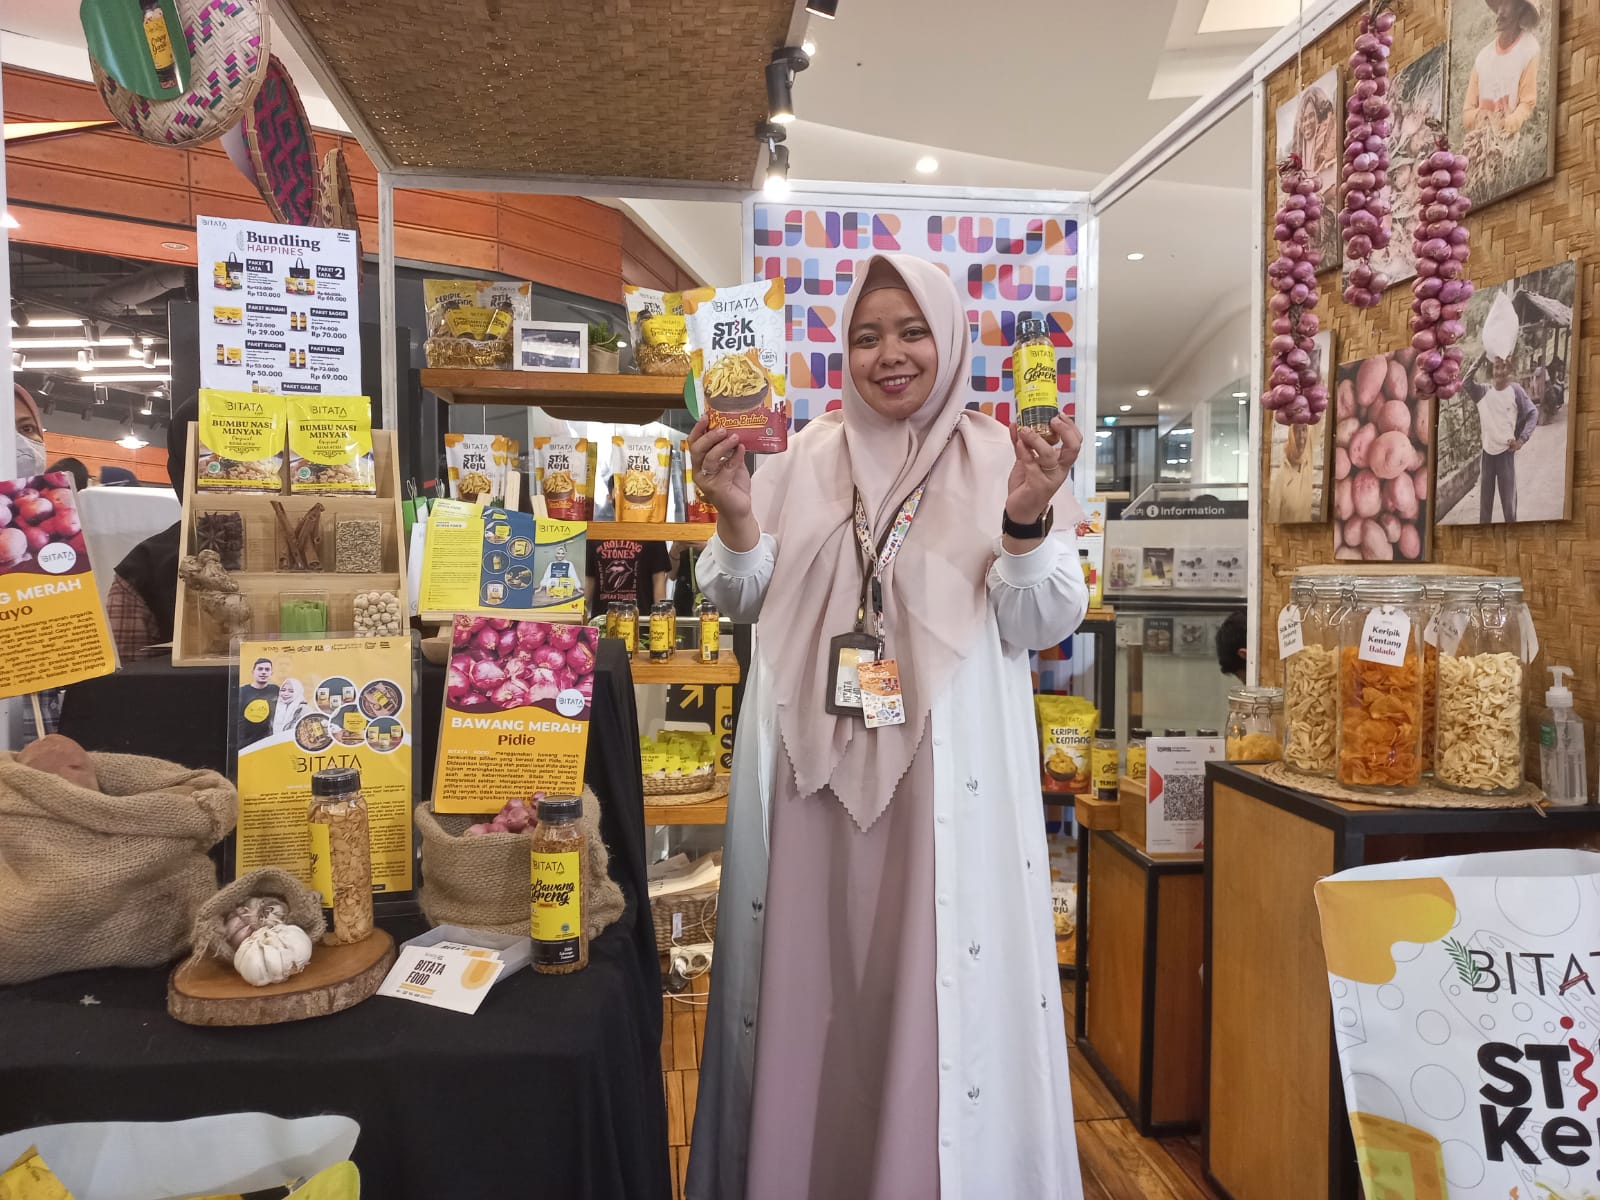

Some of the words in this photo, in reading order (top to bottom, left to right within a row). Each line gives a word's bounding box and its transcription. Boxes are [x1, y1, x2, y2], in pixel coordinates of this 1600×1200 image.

[247, 231, 320, 252] Bundling
[248, 244, 304, 256] HAPPINES
[266, 262, 270, 271] 1
[334, 268, 343, 278] 2
[713, 298, 758, 312] BITATA
[712, 334, 755, 351] Keju
[225, 401, 264, 412] BITATA
[311, 406, 347, 416] BITATA
[212, 420, 248, 428] BUMBU
[251, 421, 273, 430] NASI
[720, 416, 738, 428] Rasa
[740, 414, 768, 425] Balado
[222, 428, 262, 436] MINYAK
[463, 462, 486, 471] Keju
[548, 462, 570, 471] Keju
[628, 463, 650, 472] Keju
[1160, 506, 1225, 516] Information
[540, 524, 571, 533] BITATA
[603, 540, 642, 553] ROLLING
[41, 552, 75, 562] BITATA
[601, 550, 636, 559] STONES
[16, 578, 82, 602] MERAH
[1372, 626, 1400, 637] Keripik
[1368, 635, 1402, 648] Kentang
[1369, 646, 1396, 656] Balado
[558, 697, 584, 706] BITATA
[452, 717, 524, 731] BAWANG
[528, 721, 582, 734] MERAH
[1050, 728, 1079, 736] KERIPIK
[498, 734, 536, 746] Pidie
[1056, 736, 1091, 744] KENTANG
[296, 754, 362, 772] BITATA
[532, 861, 564, 872] BITATA
[536, 878, 575, 893] Bawang
[1053, 906, 1068, 914] eju
[414, 960, 446, 976] BITATA
[405, 971, 430, 986] FOOD
